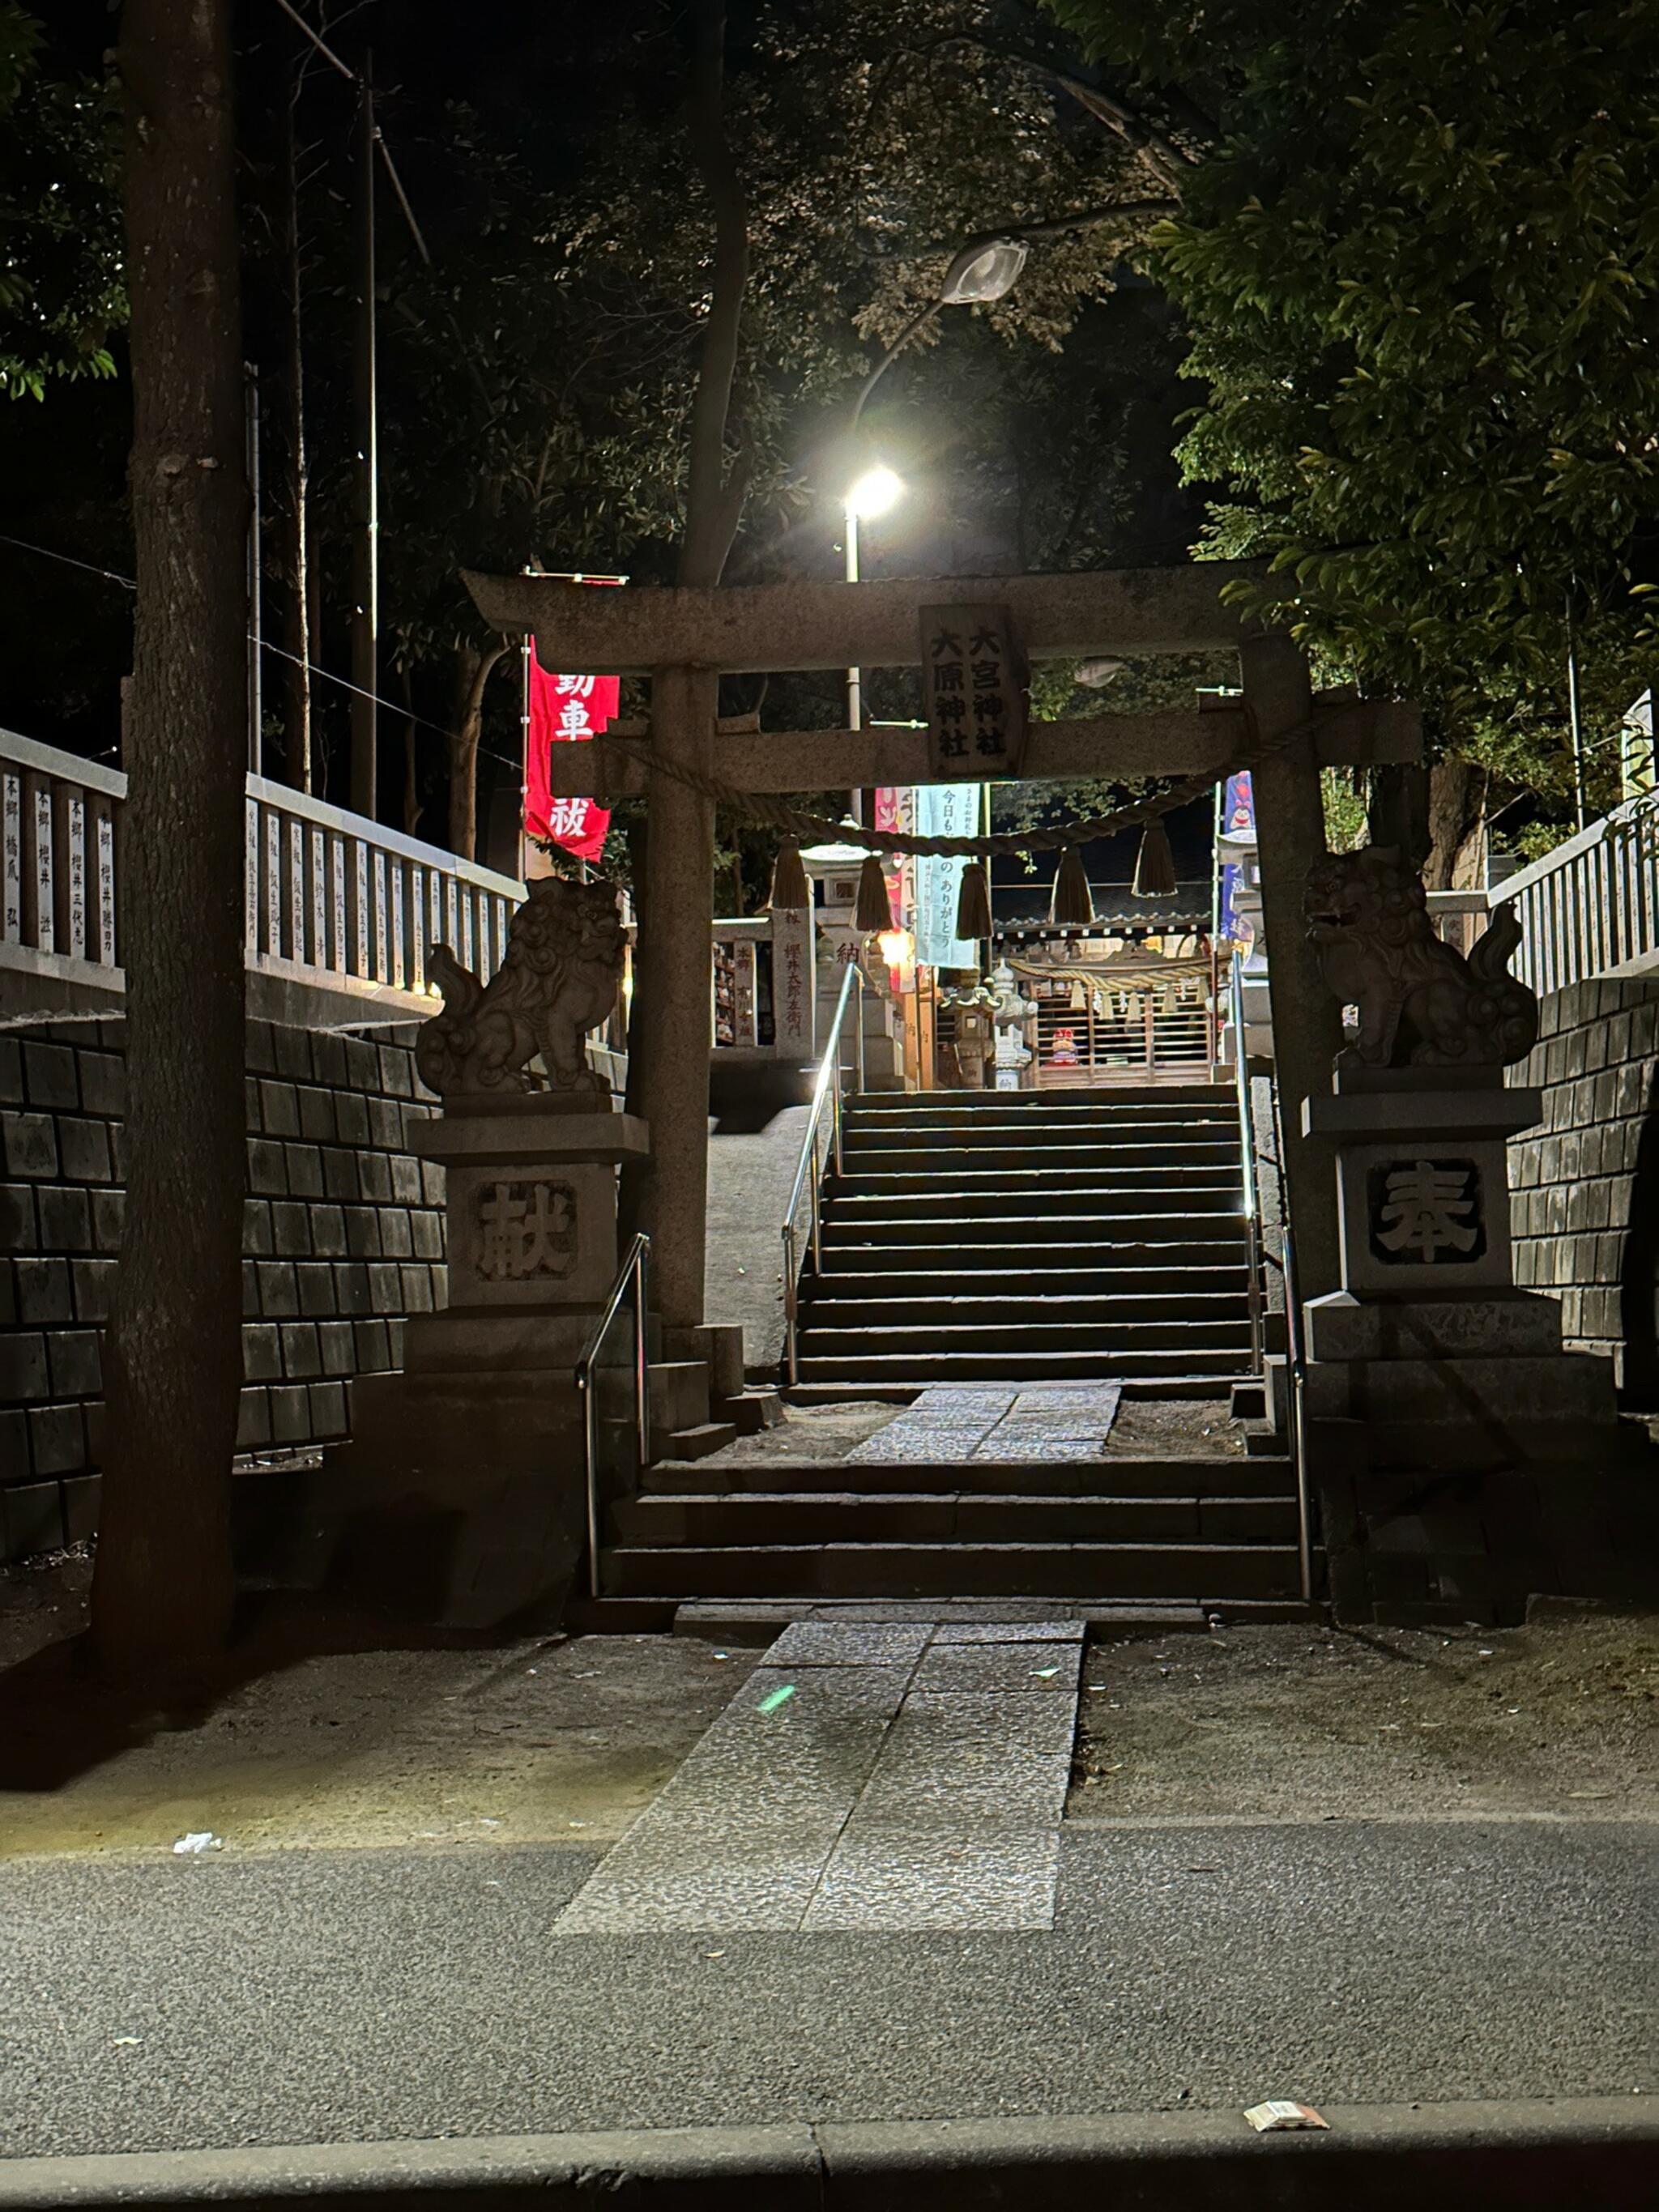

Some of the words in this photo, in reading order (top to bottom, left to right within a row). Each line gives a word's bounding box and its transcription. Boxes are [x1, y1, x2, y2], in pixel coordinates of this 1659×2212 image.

[931, 620, 970, 758] 大原神社
[969, 619, 1008, 756] 大宮神社
[940, 880, 953, 948] ありがとう
[480, 1183, 571, 1280] 献
[1374, 1161, 1478, 1264] 奉
